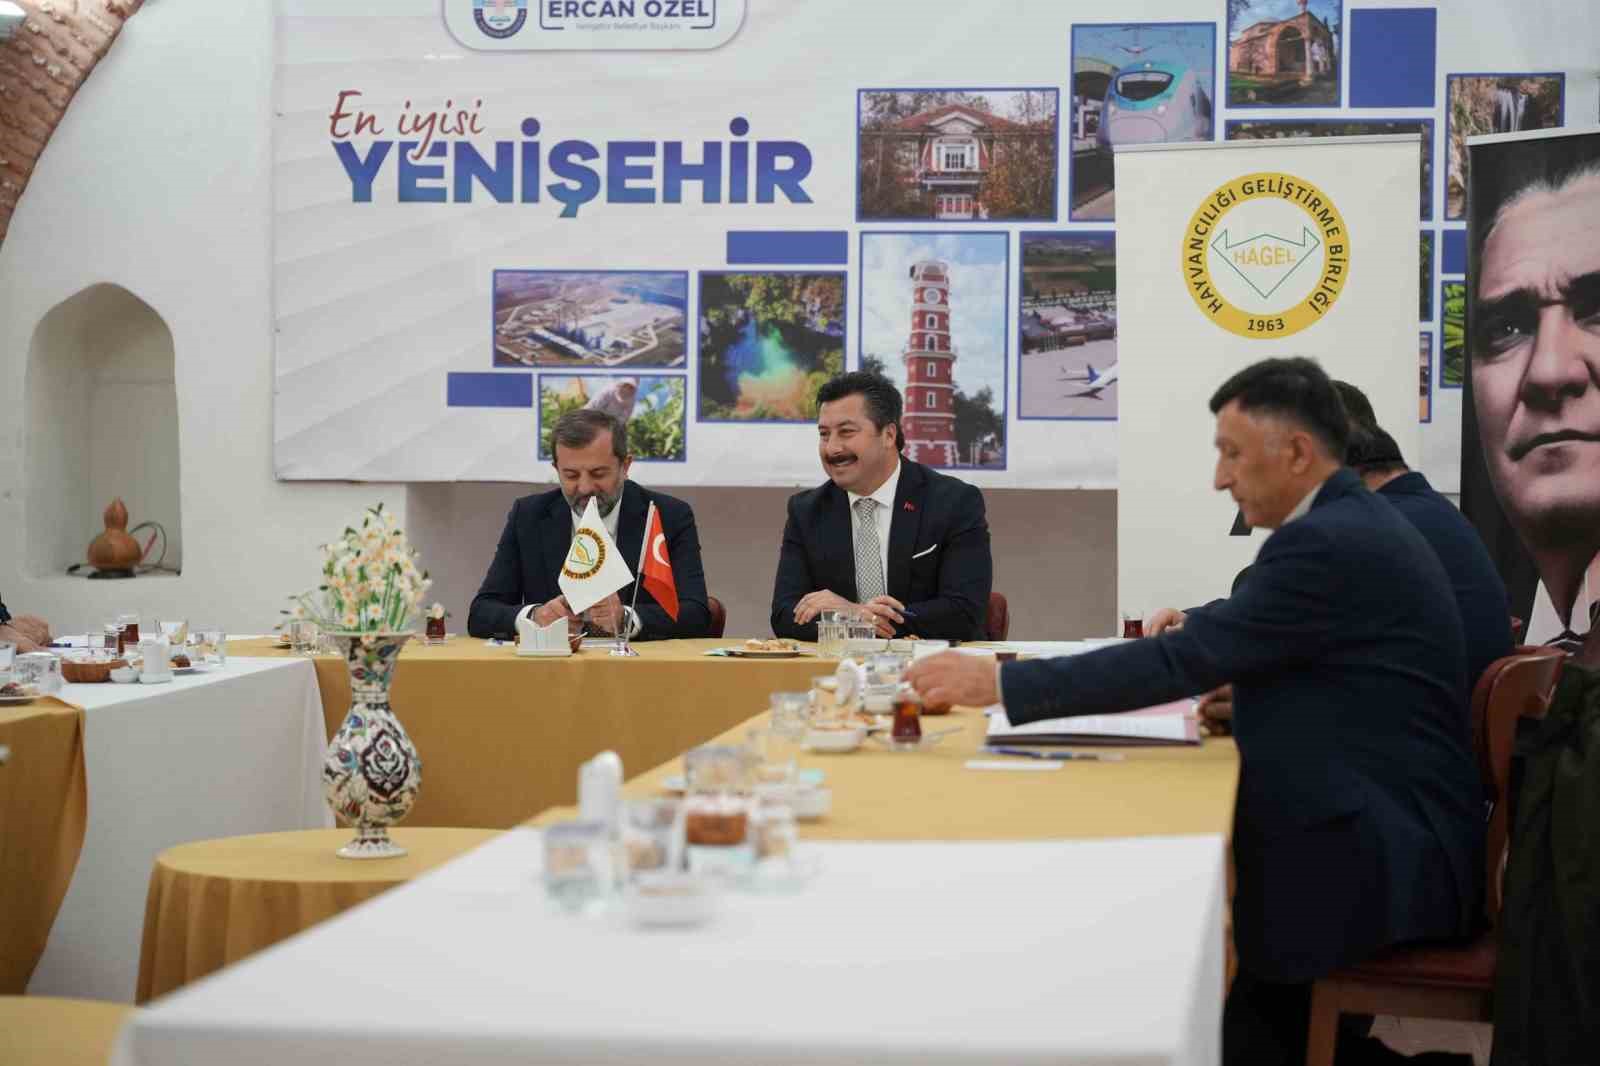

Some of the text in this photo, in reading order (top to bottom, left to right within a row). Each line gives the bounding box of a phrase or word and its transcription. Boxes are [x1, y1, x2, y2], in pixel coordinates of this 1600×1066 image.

[549, 0, 635, 18] ERCAN
[330, 90, 487, 161] En iyisi
[331, 117, 814, 218] YENİŞEHİR
[1188, 188, 1238, 314] HAYVANCILIĞI
[1241, 176, 1341, 239] GELİŞTİRME
[1233, 246, 1297, 267] HAGEL
[1247, 318, 1285, 332] 1963
